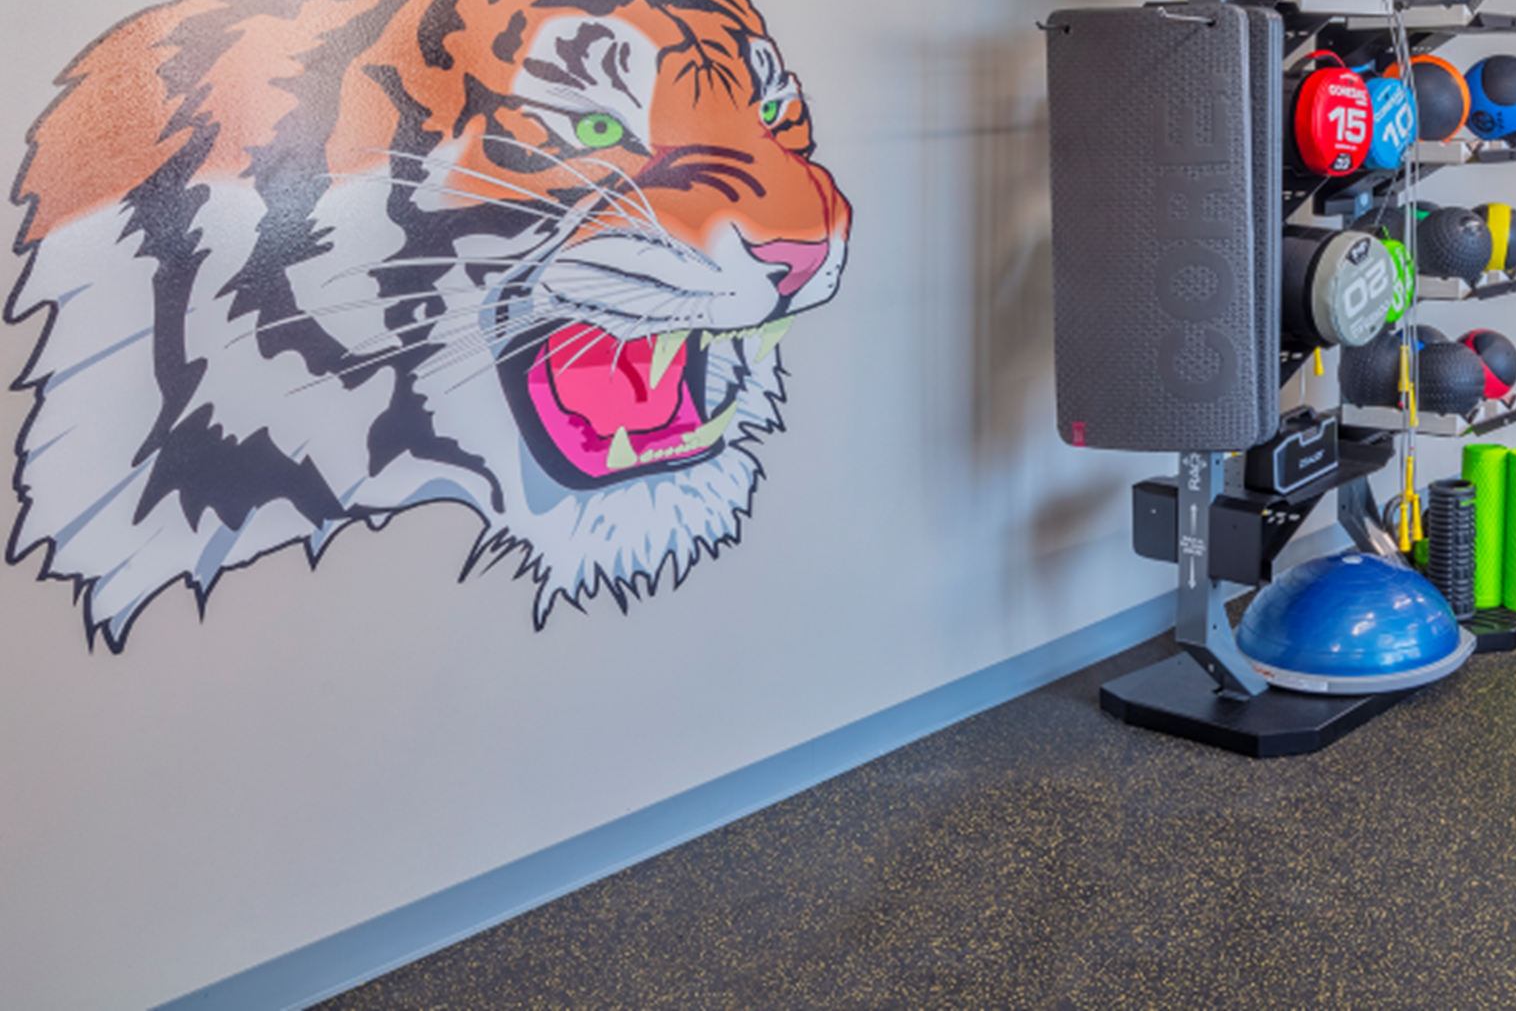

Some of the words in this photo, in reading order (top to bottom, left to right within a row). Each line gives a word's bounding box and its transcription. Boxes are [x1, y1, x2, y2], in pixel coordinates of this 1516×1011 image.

[1327, 105, 1367, 144] 15
[1381, 102, 1415, 148] 10
[1342, 258, 1390, 320] 20
